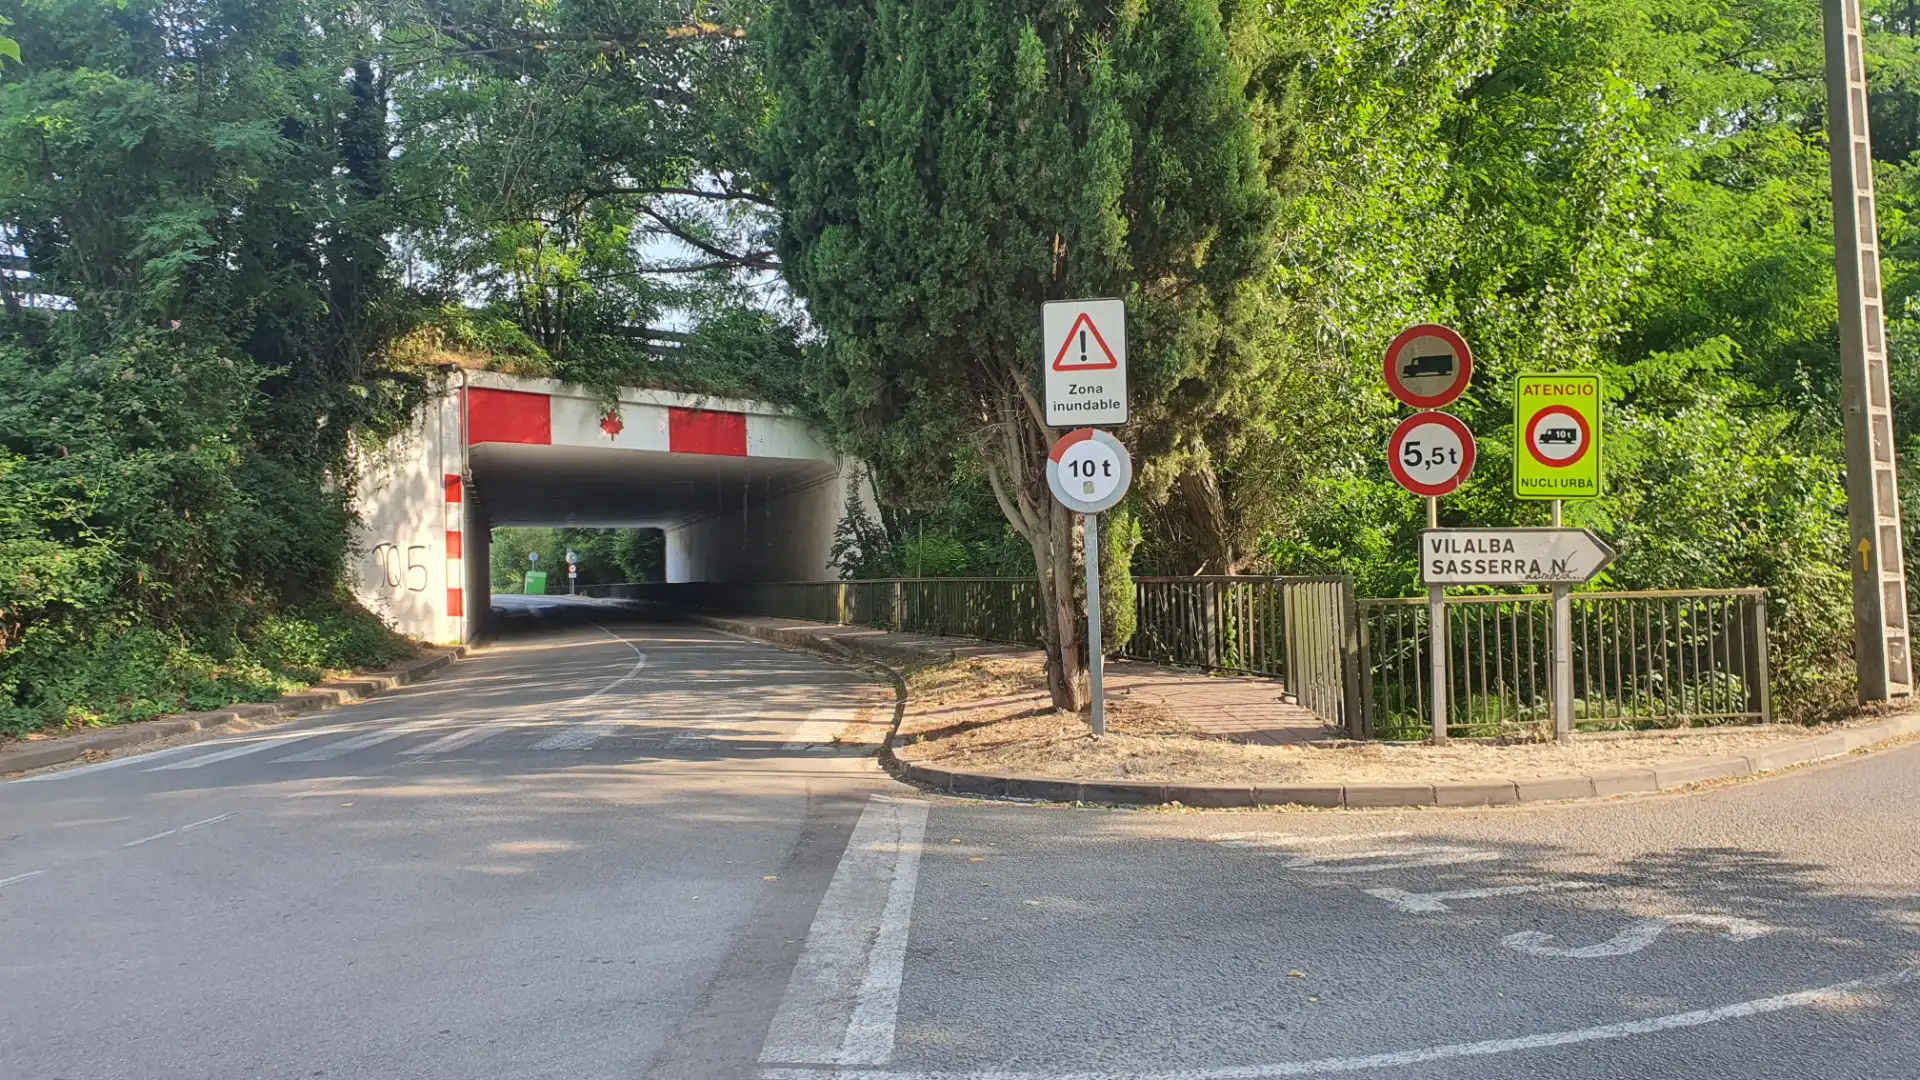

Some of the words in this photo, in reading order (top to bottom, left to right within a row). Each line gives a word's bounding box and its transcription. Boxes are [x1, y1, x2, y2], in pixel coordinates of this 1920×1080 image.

[1069, 384, 1103, 395] Zona
[1523, 381, 1594, 396] ATENCIÓ
[1053, 399, 1121, 412] inundable
[1555, 430, 1567, 438] 10
[1068, 459, 1096, 478] 10
[1102, 459, 1112, 477] t
[1521, 478, 1558, 488] NUCLI
[1561, 477, 1594, 488] URBÀ
[1431, 538, 1515, 553] VILALBA
[1432, 559, 1541, 574] SASSERRA
